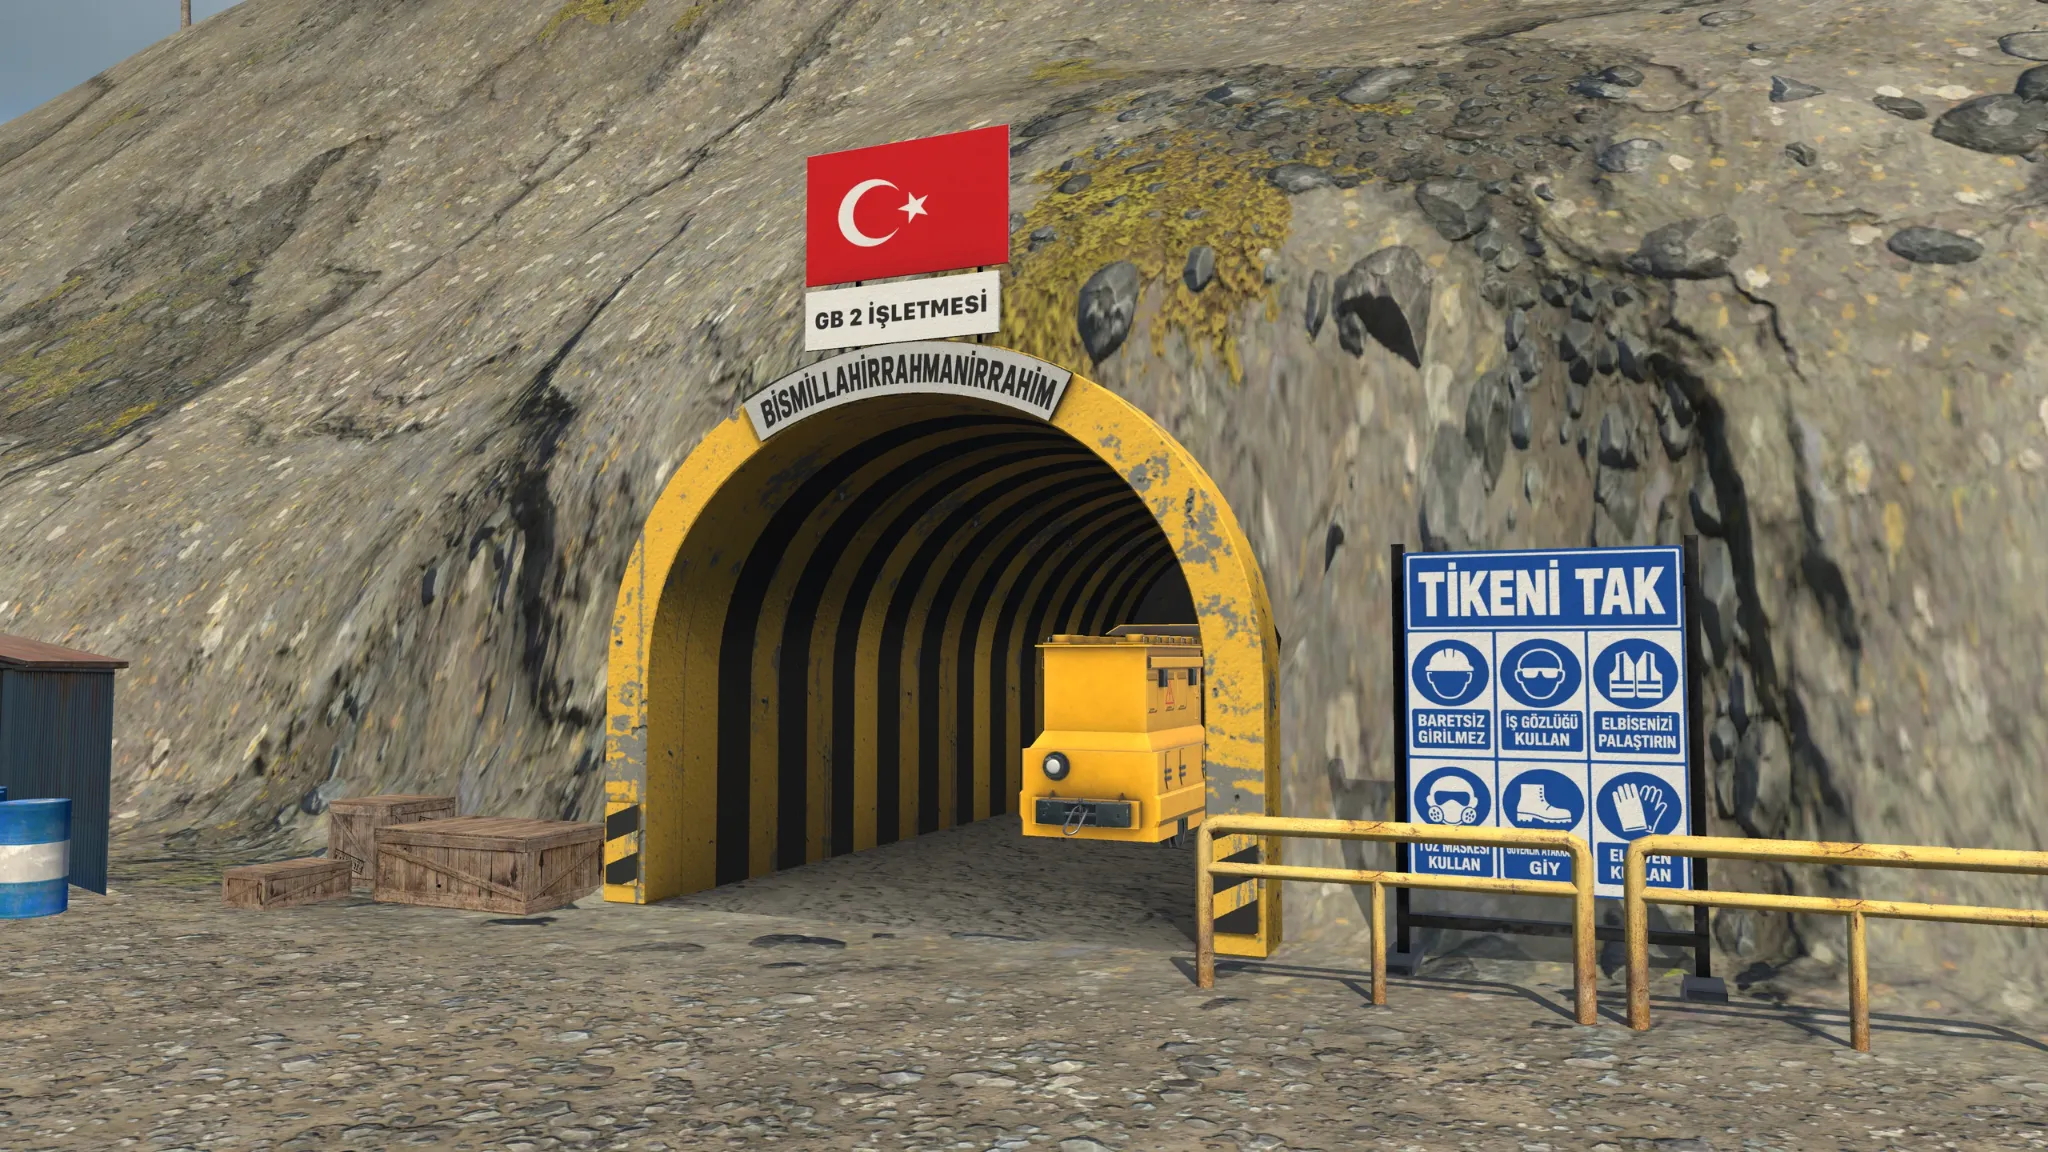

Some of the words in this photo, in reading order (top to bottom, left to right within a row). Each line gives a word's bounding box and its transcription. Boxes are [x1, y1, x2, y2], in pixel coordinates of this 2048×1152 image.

[815, 310, 844, 330] GB
[850, 308, 862, 327] 2
[869, 288, 987, 329] İŞLETMESİ
[760, 350, 1057, 430] BİSMİLLAHİRRAHMANİRRAHİM
[1418, 559, 1560, 617] TİKENİ
[1575, 566, 1666, 616] TAK
[1418, 712, 1485, 728] BARETSİZ
[1505, 713, 1518, 731] İŞ
[1521, 713, 1578, 730] GÖZLÜĞÜ
[1601, 714, 1673, 732] ELBİSENİZİ
[1418, 728, 1486, 745] GİRİLMEZ
[1514, 732, 1570, 747] KULLAN
[1598, 733, 1677, 751] PALAŞTIRIN
[1428, 855, 1481, 872] KULLAN
[1529, 859, 1561, 876] GİY
